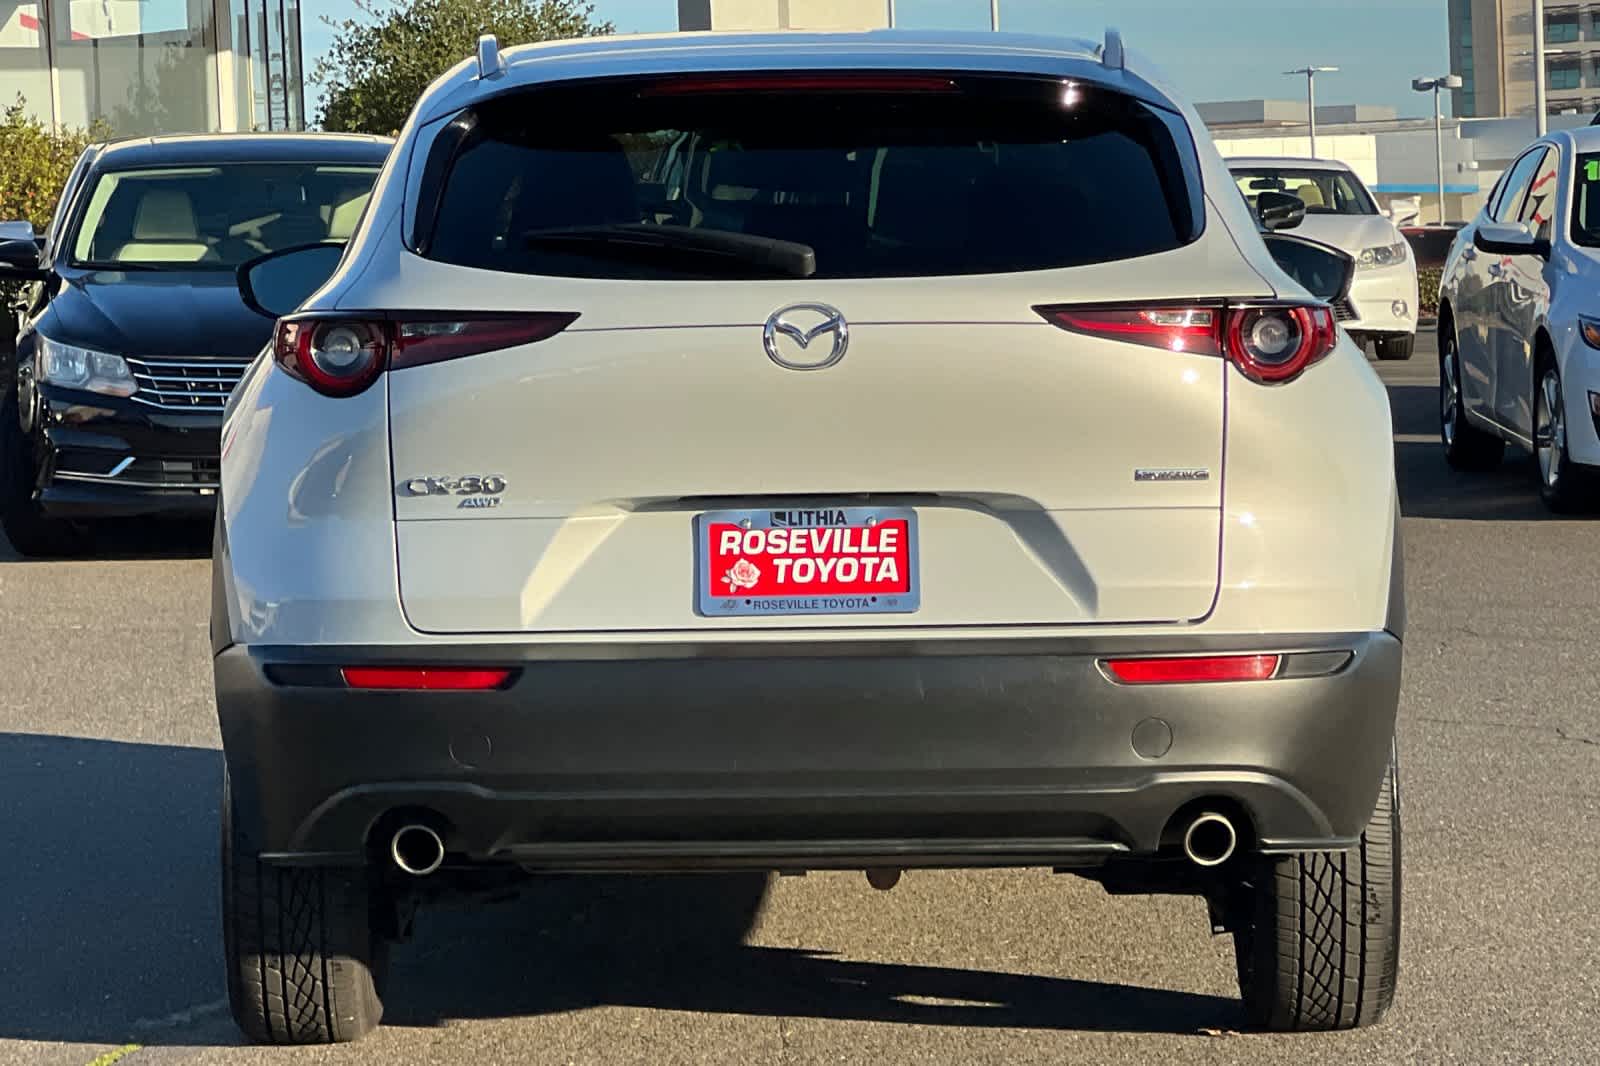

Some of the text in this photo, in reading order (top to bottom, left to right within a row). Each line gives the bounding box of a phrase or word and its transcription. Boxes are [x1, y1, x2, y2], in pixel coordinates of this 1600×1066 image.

[397, 475, 507, 497] CX-30
[787, 510, 847, 526] LITHIA
[719, 528, 898, 555] ROSEVILLE
[773, 557, 899, 583] TOYOTA
[753, 598, 870, 610] ROSEVILLE TOYOTA
